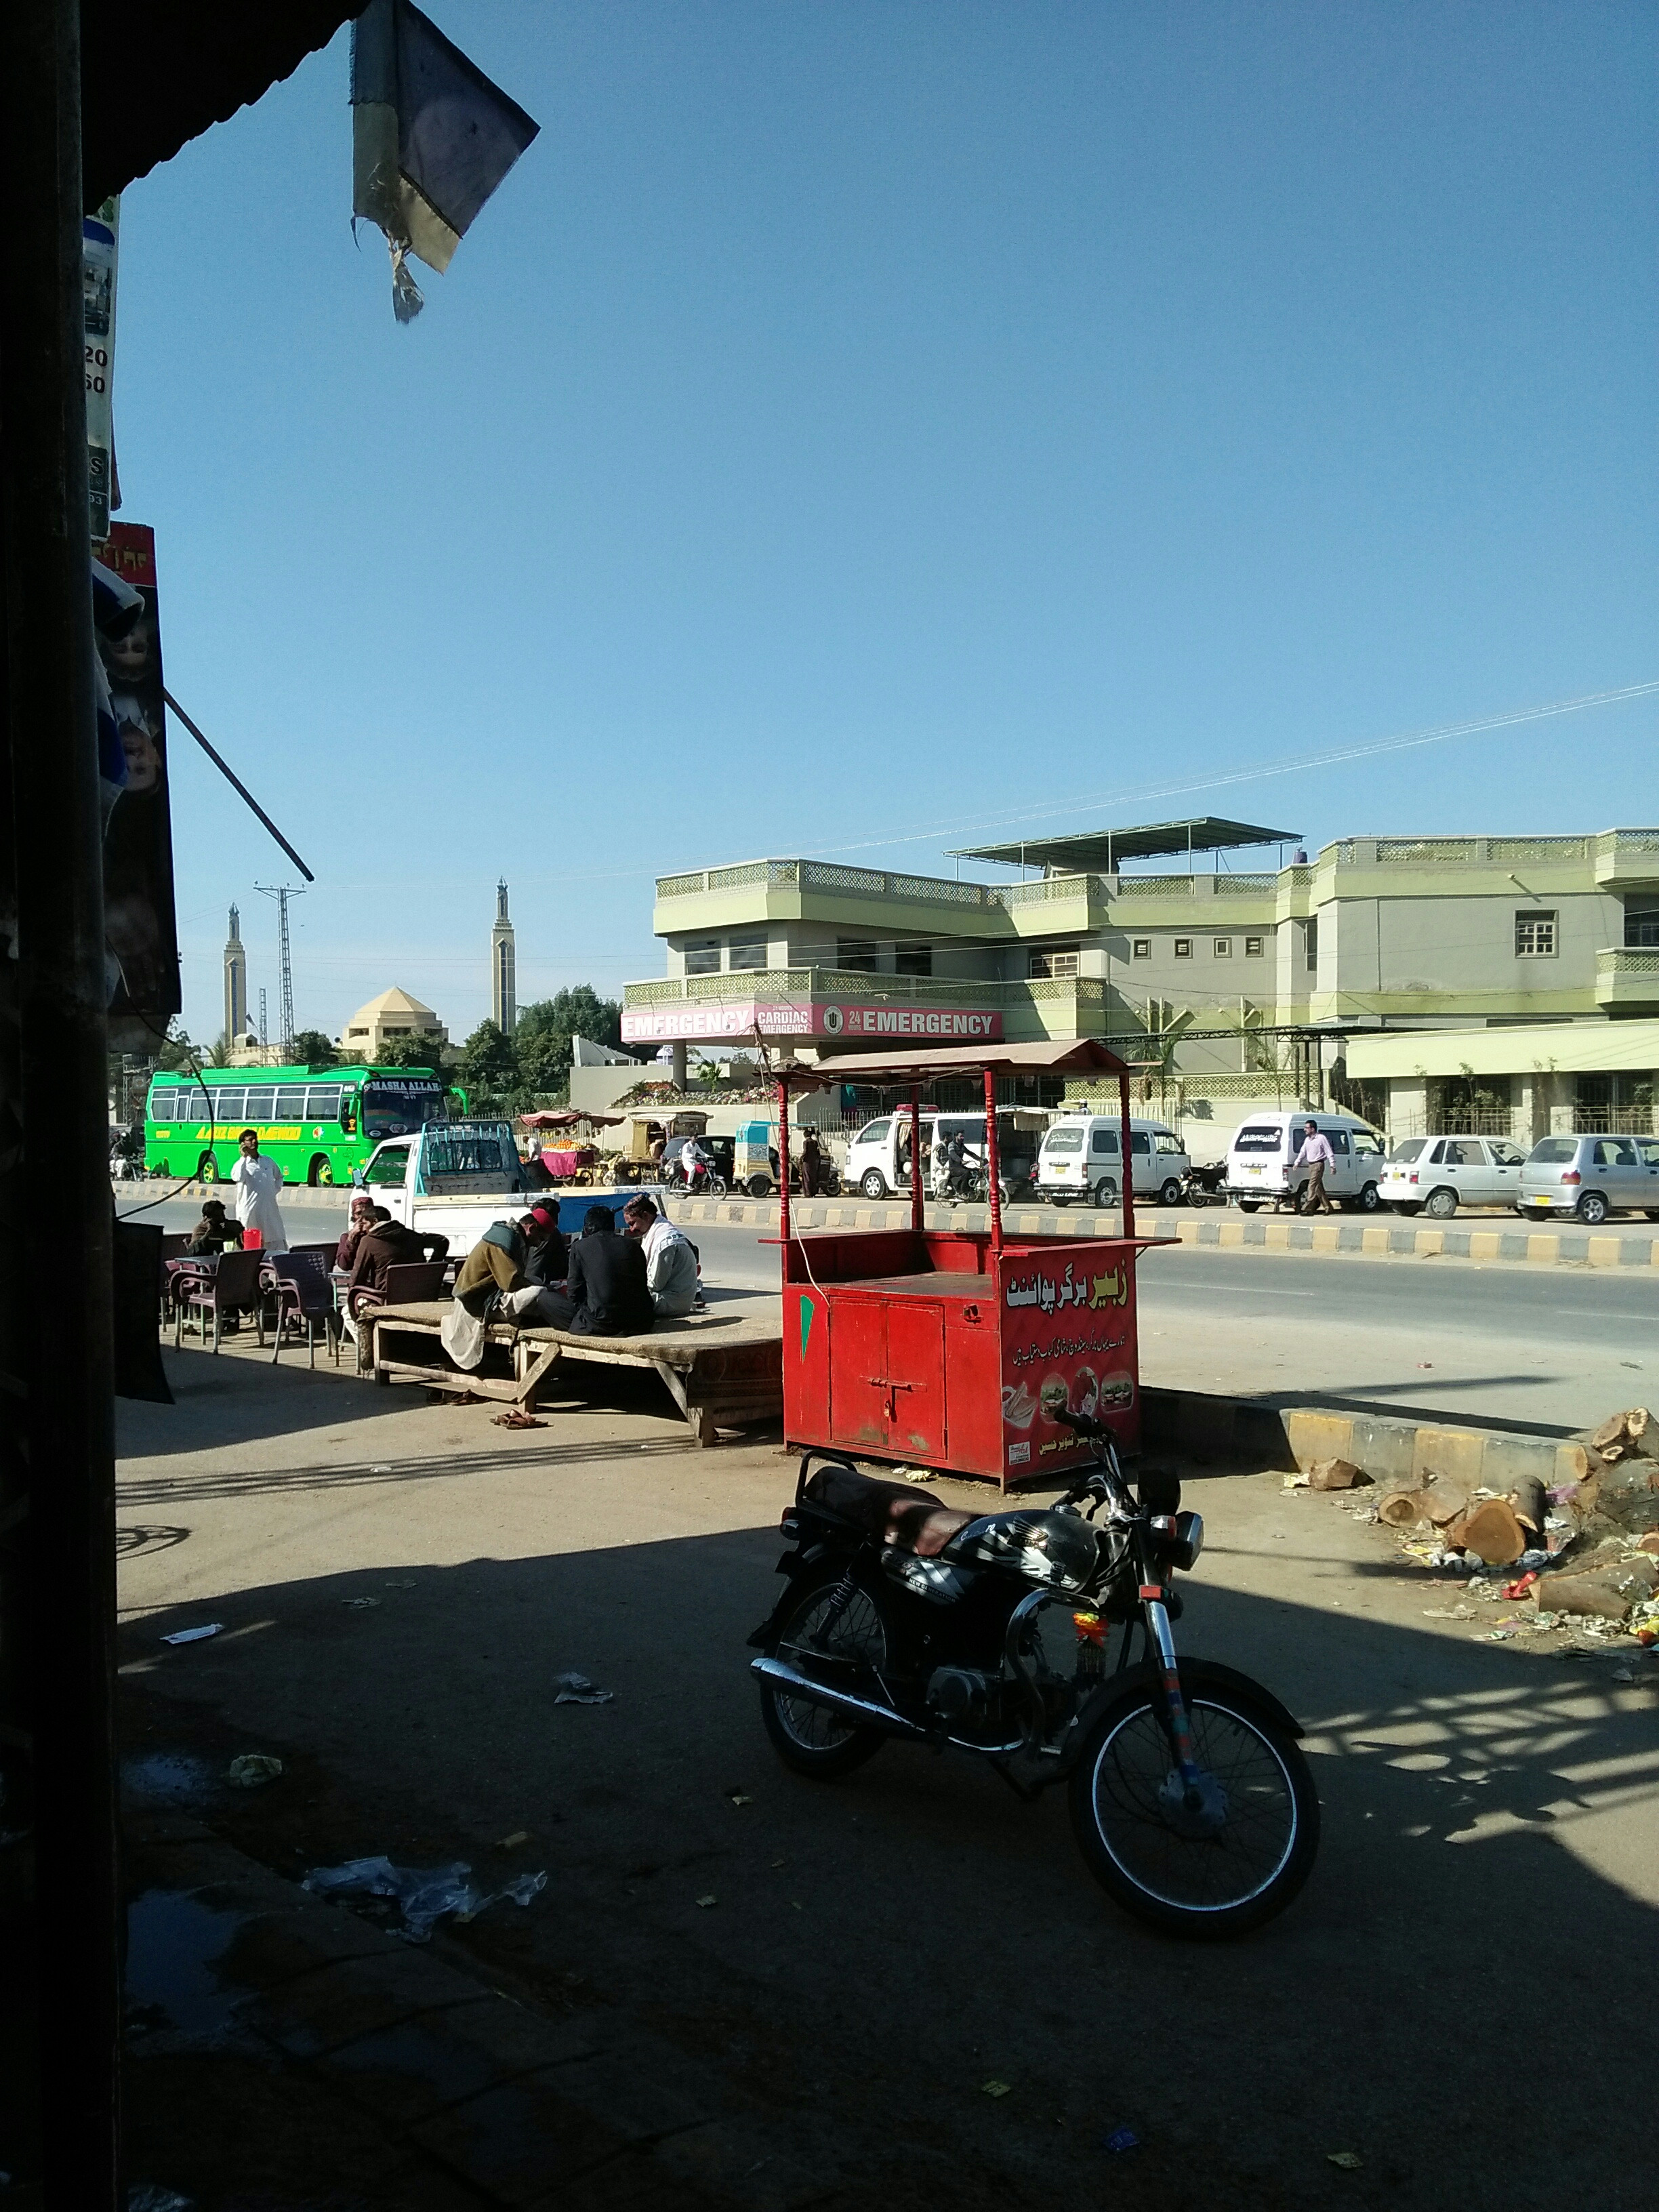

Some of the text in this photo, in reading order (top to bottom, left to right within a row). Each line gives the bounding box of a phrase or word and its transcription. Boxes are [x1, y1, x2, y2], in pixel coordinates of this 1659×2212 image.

[623, 1010, 750, 1038] EMERGENCY
[758, 1011, 808, 1024] CARDIAC
[848, 1010, 861, 1024] 24
[863, 1010, 994, 1034] EMERGENCY
[759, 1024, 808, 1034] EMERGENCY
[372, 1081, 440, 1092] MASHA ALLAH
[1006, 1258, 1128, 1316] زبیر برگر پوائنٹ
[921, 1583, 956, 1603] GENERATION
